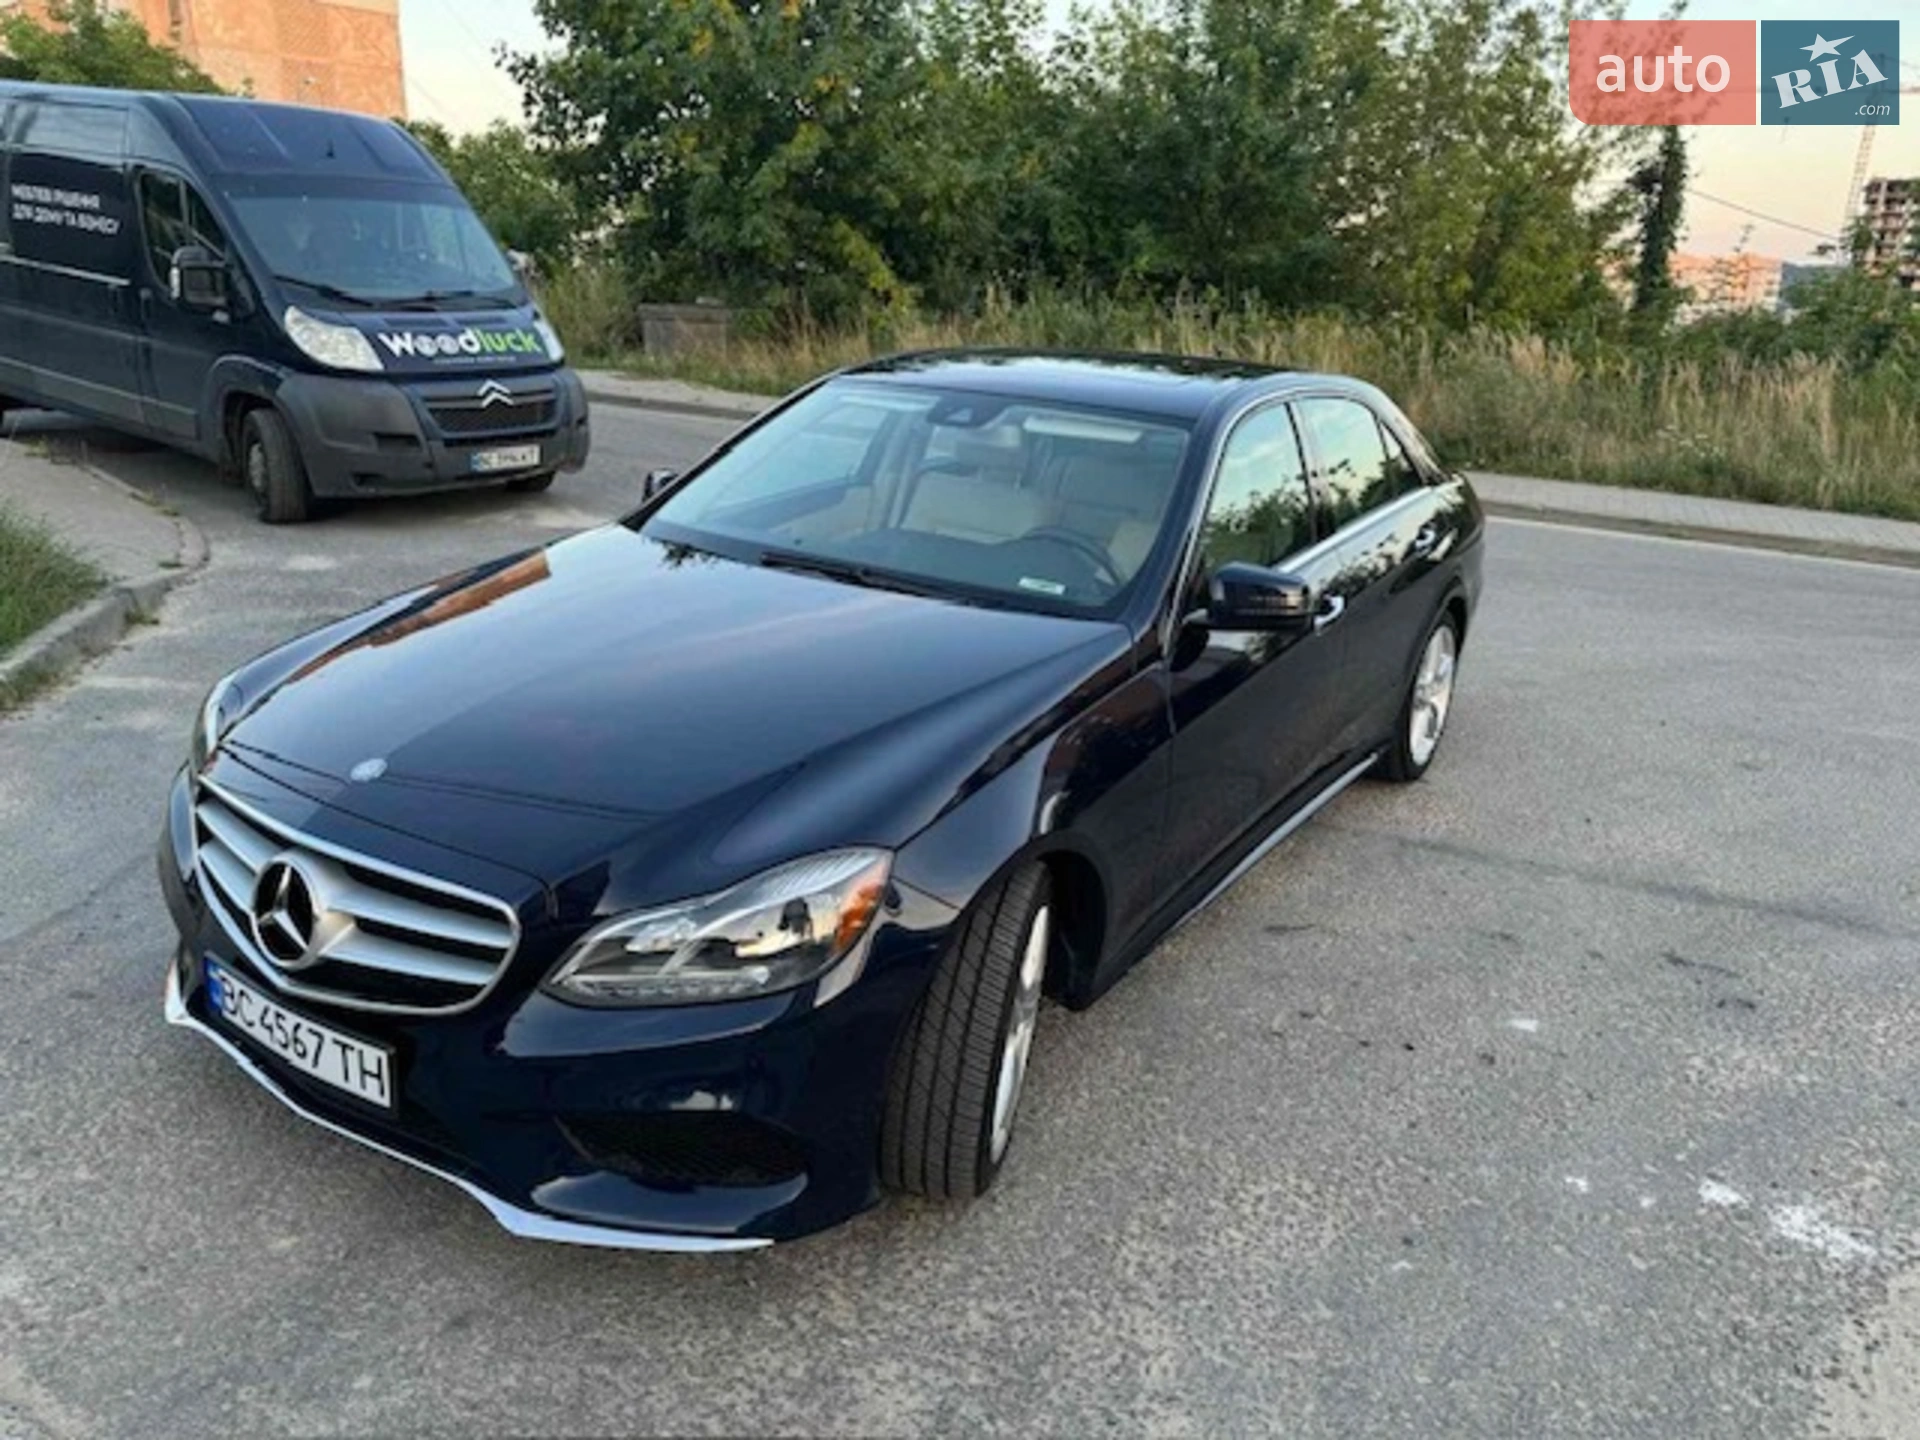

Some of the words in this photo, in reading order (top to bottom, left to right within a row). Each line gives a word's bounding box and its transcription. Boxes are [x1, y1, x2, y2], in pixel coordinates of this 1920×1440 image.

[377, 327, 543, 358] Woodluck
[220, 974, 256, 1028] BC
[260, 1004, 325, 1069] 4567
[332, 1036, 386, 1098] TH
